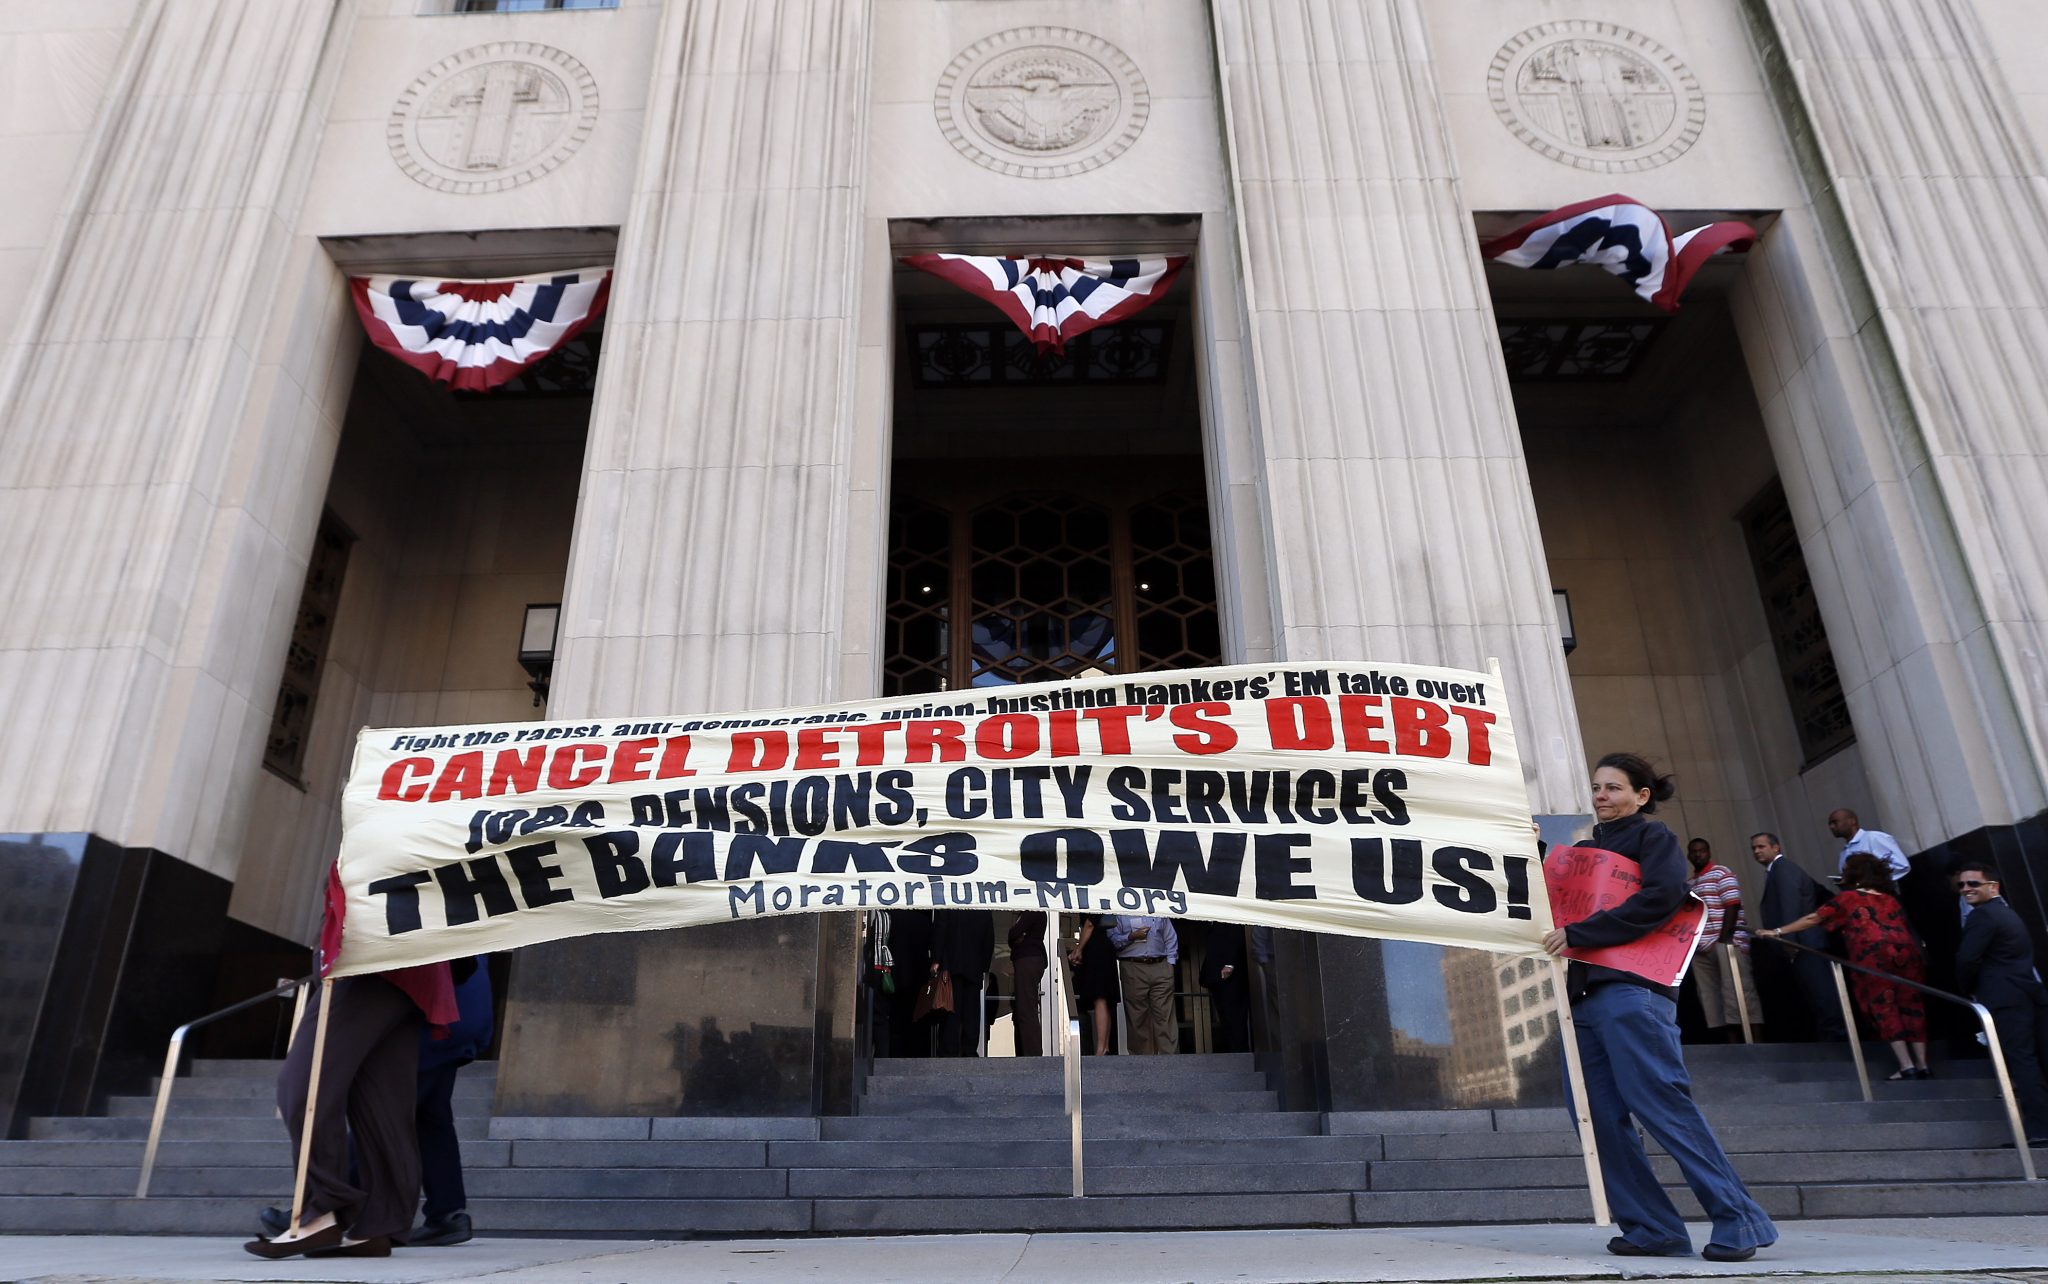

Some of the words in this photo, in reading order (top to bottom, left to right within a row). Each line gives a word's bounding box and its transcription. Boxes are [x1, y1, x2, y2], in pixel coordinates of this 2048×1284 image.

[377, 734, 697, 803] CANCEL
[1265, 695, 1496, 766] DEBT
[390, 732, 460, 753] Fight
[463, 729, 510, 747] the
[880, 687, 1116, 720] union-busting
[1285, 669, 1330, 698] EM
[1338, 671, 1409, 697] take
[1416, 678, 1485, 706] over!
[629, 769, 928, 837] PENSIONS,
[945, 765, 1092, 820] CITY
[1107, 766, 1411, 826] SERVICES
[369, 839, 574, 935] THE
[582, 830, 978, 899] BANKS
[1020, 828, 1317, 900] OWE
[1351, 837, 1532, 921] US!
